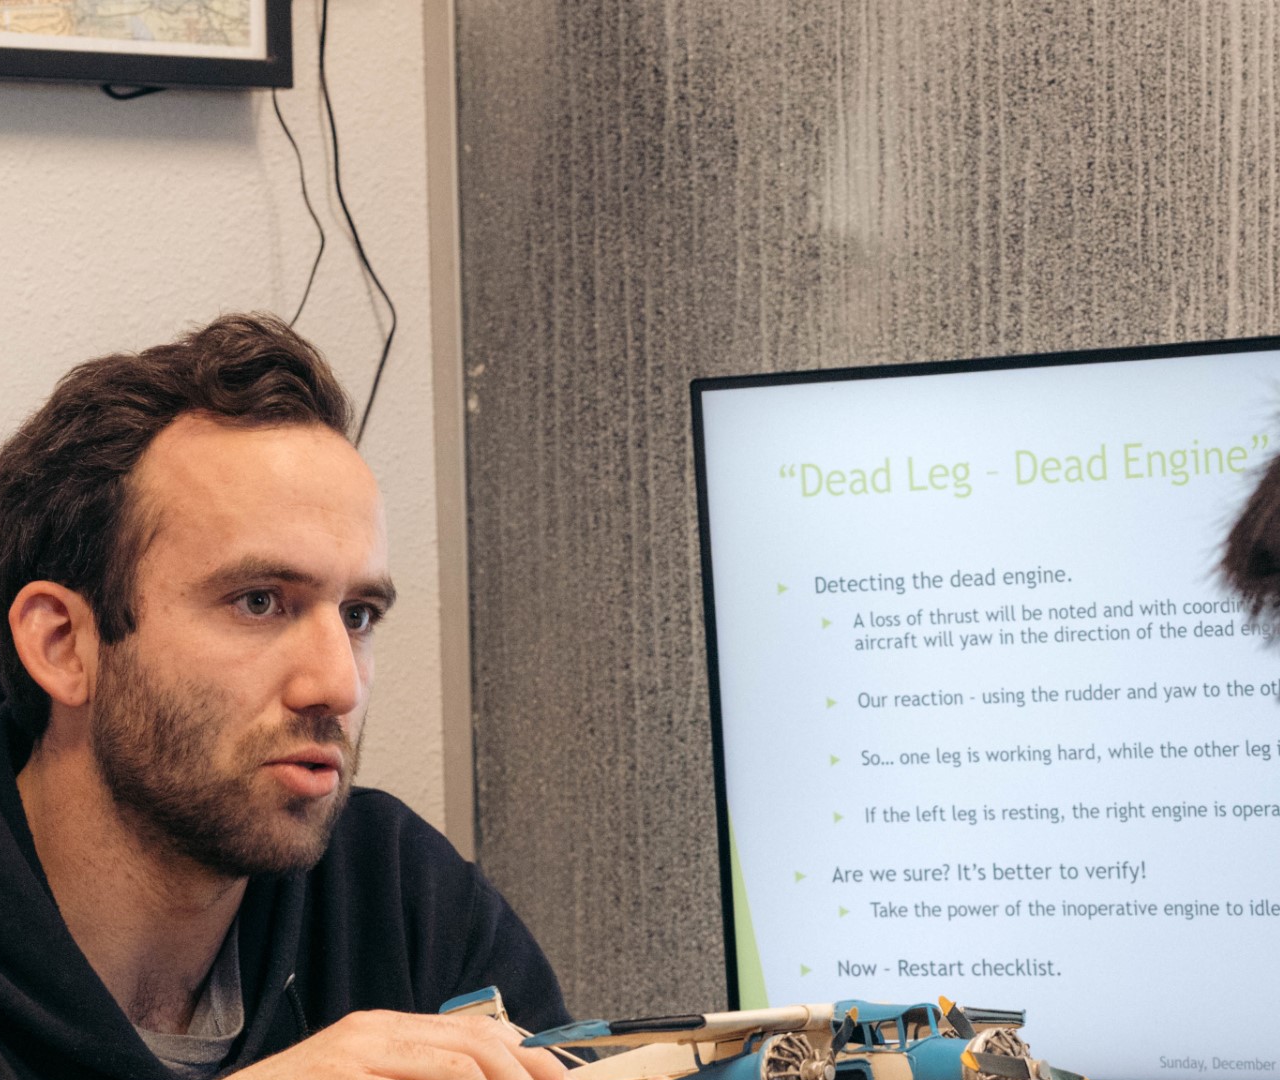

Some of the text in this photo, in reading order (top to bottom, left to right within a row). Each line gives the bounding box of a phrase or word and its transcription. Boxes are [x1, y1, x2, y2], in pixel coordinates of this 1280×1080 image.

[780, 458, 891, 497] “Dead
[908, 457, 972, 498] Leg
[1016, 444, 1107, 485] Dead
[1124, 435, 1269, 486] Engine”
[814, 565, 1073, 596] Detecting the dead engine.
[852, 612, 866, 629] A
[869, 610, 902, 628] loss
[905, 608, 924, 627] of
[928, 607, 981, 626] thrust
[984, 604, 1017, 623] will
[1021, 604, 1044, 622] be
[1047, 601, 1097, 621] noted
[1102, 599, 1134, 619] and
[1138, 598, 1177, 617] with
[854, 631, 918, 652] aircraft
[922, 630, 955, 648] will
[959, 633, 994, 652] yaw
[998, 628, 1015, 645] in
[1019, 626, 1049, 645] the
[1053, 624, 1131, 644] direction
[1135, 621, 1154, 640] of
[1158, 621, 1188, 640] the
[1192, 618, 1235, 638] dead
[857, 691, 888, 709] Our
[893, 689, 964, 708] reaction
[981, 687, 1027, 708] using
[1030, 685, 1060, 703] the
[1064, 683, 1122, 702] rudder
[1126, 681, 1158, 700] and
[1162, 685, 1198, 704] yaw
[1202, 682, 1221, 698] to
[1225, 679, 1255, 698] the
[860, 749, 895, 767] So...
[899, 751, 931, 766] one
[935, 746, 962, 769] leg
[966, 746, 981, 764] is
[984, 744, 1053, 766] working
[1057, 742, 1102, 764] hard,
[1107, 741, 1155, 760] while
[1159, 740, 1189, 759] the
[1193, 739, 1241, 759] other
[1245, 739, 1272, 762] leg
[865, 806, 877, 824] If
[882, 806, 911, 824] the
[915, 804, 947, 823] left
[951, 804, 978, 826] leg
[982, 804, 997, 821] is
[1001, 803, 1065, 825] resting,
[1071, 801, 1101, 820] the
[1105, 800, 1146, 824] right
[1151, 800, 1209, 823] engine
[1213, 800, 1228, 818] is
[831, 860, 1147, 885] Are we sure? It’s better to verify!
[869, 901, 909, 919] Take
[913, 900, 943, 918] the
[947, 904, 1000, 922] power
[1004, 899, 1023, 917] of
[1027, 899, 1057, 917] the
[1061, 899, 1159, 921] inoperative
[1163, 899, 1221, 921] engine
[1225, 901, 1244, 917] to
[837, 959, 878, 978] Now
[897, 958, 966, 978] Restart
[970, 958, 1062, 977] checklist.
[1159, 1056, 1207, 1072] Sunday,
[1213, 1057, 1277, 1071] December
